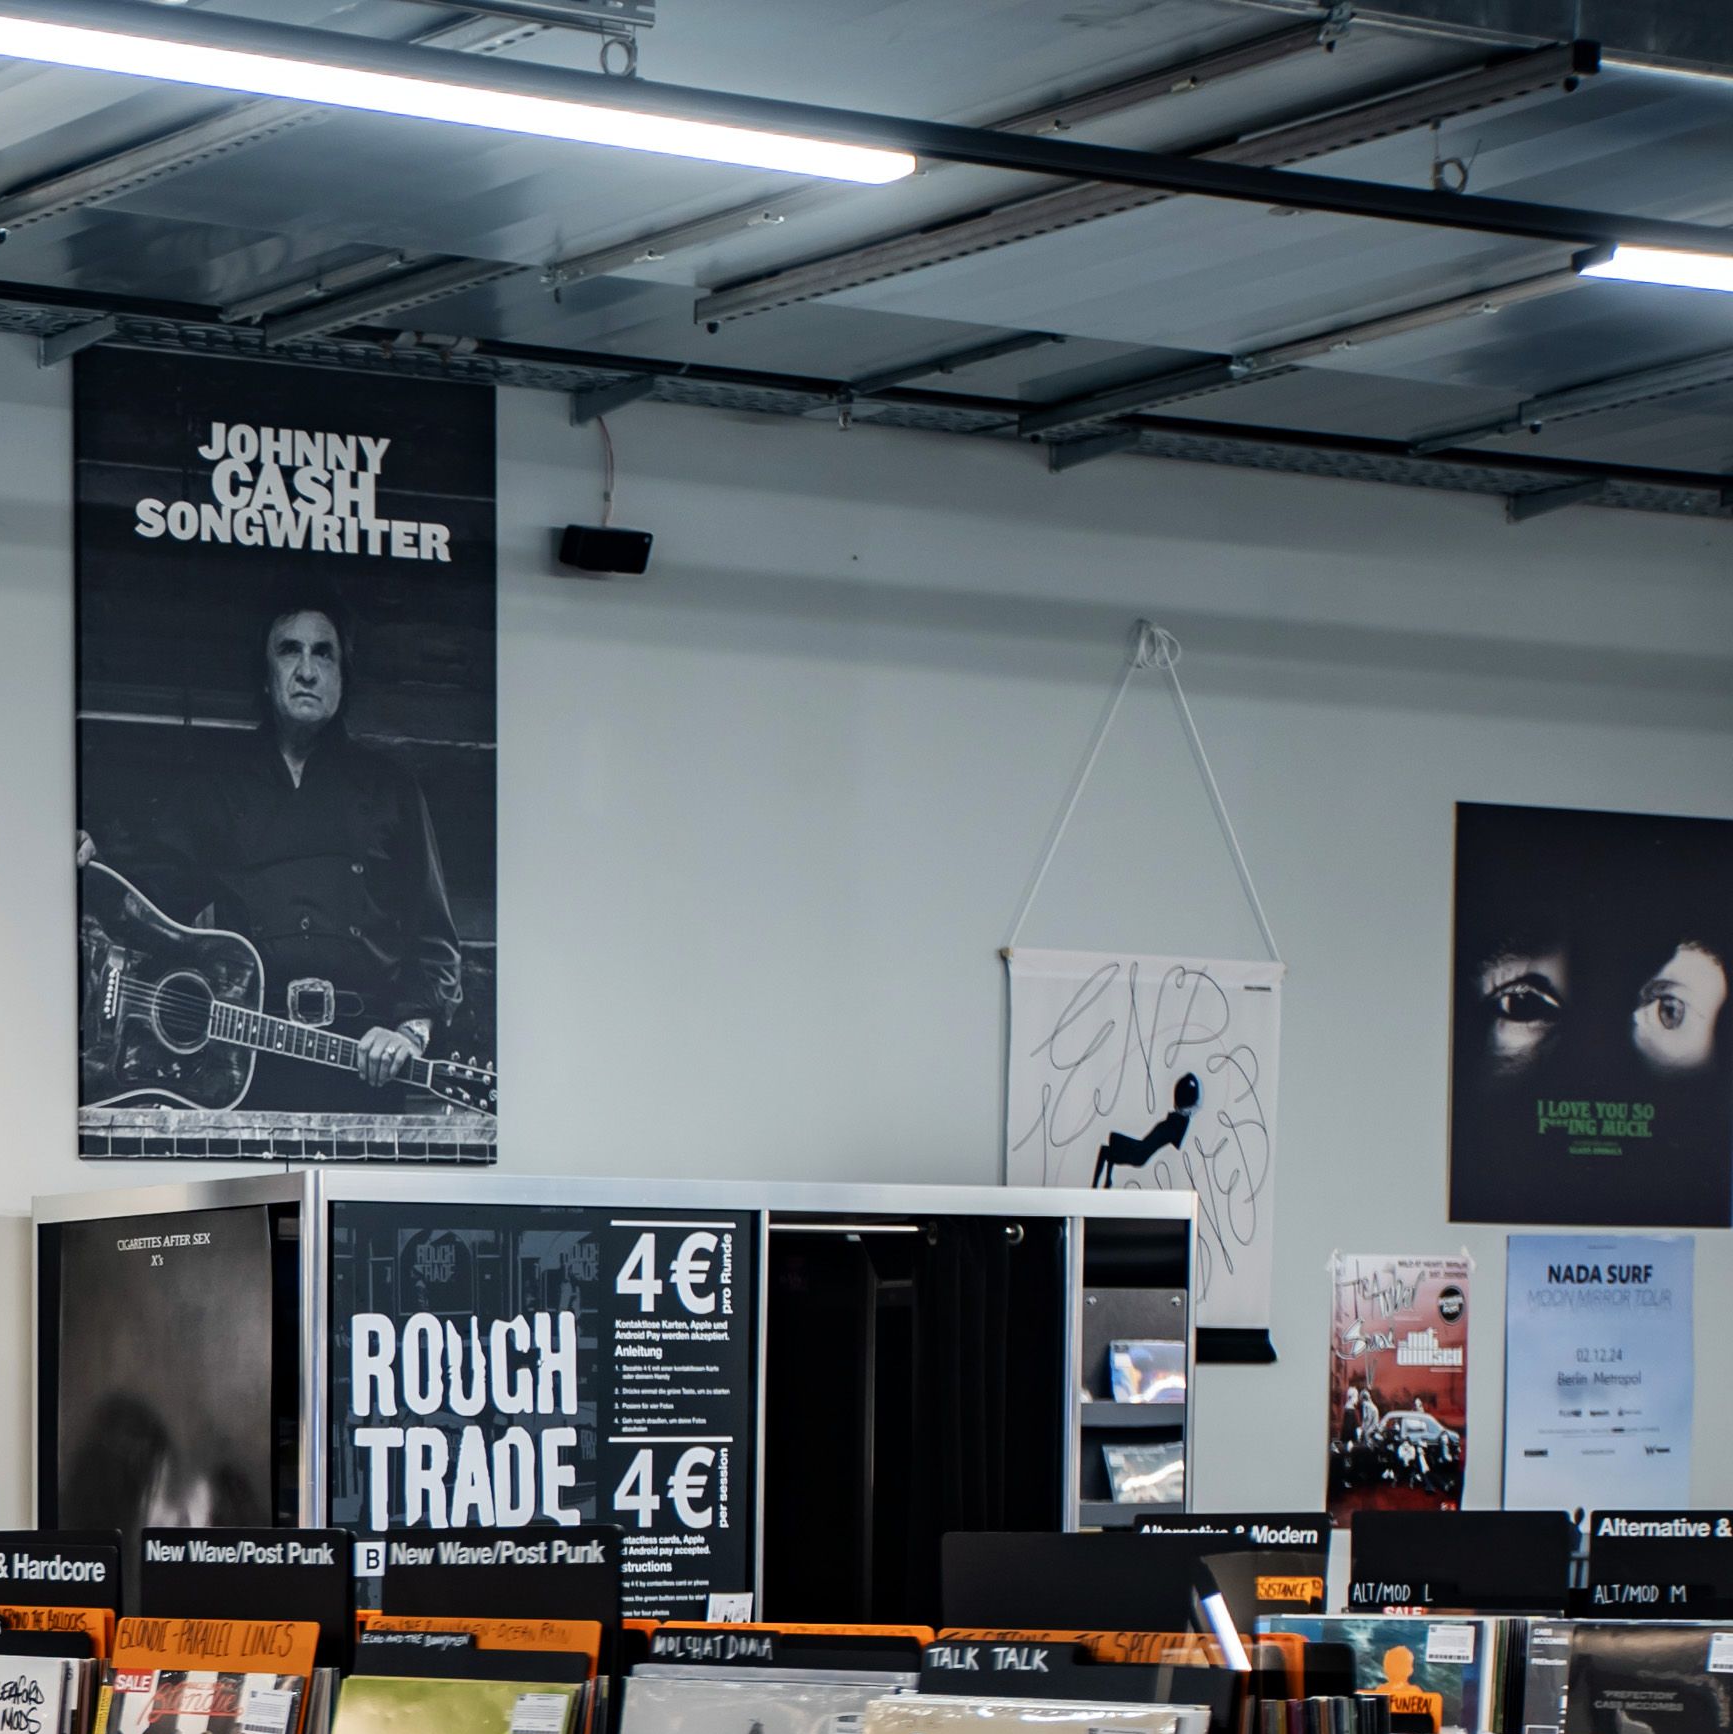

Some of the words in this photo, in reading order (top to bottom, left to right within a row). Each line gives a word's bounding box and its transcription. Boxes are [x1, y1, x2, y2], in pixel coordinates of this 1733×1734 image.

[198, 420, 391, 477] JOHNNY
[211, 458, 377, 526] CASH
[135, 498, 452, 563] SONGWRITER
[1538, 1100, 1544, 1116] I
[1549, 1101, 1589, 1117] LOVE
[1596, 1103, 1627, 1118] YOU
[1633, 1104, 1654, 1119] SO
[117, 1236, 161, 1252] CIGARETTES
[163, 1234, 190, 1249] AFTER
[194, 1232, 211, 1245] SEX
[720, 1233, 733, 1284] Runde
[1548, 1264, 1601, 1283] NADA
[1608, 1264, 1653, 1283] SURF
[351, 1310, 578, 1417] ROUGH
[615, 1345, 663, 1359] Anleitung
[1576, 1349, 1622, 1362] 02.12.24
[1557, 1372, 1587, 1386] Berlin
[1594, 1372, 1642, 1387] Metropol
[354, 1425, 581, 1532] TRADE
[718, 1448, 729, 1501] session
[1253, 1525, 1318, 1545] Modern
[1598, 1518, 1711, 1538] Alternative
[1715, 1518, 1732, 1537] &
[146, 1539, 184, 1563] New
[186, 1541, 285, 1565] Wave/Post
[288, 1543, 334, 1565] Punk
[365, 1547, 382, 1569] B
[390, 1541, 431, 1566] New
[434, 1542, 548, 1567] Wave/Post
[553, 1540, 605, 1564] Punk
[12, 1555, 106, 1582] Hardcore
[1353, 1583, 1411, 1601] ALT/MOD
[1422, 1583, 1433, 1601] L
[1595, 1585, 1659, 1603] ALT/MOD
[929, 1647, 979, 1670] TALK
[993, 1648, 1049, 1672] TALK
[115, 1672, 151, 1692] SALE
[1, 1707, 42, 1734] MODS
